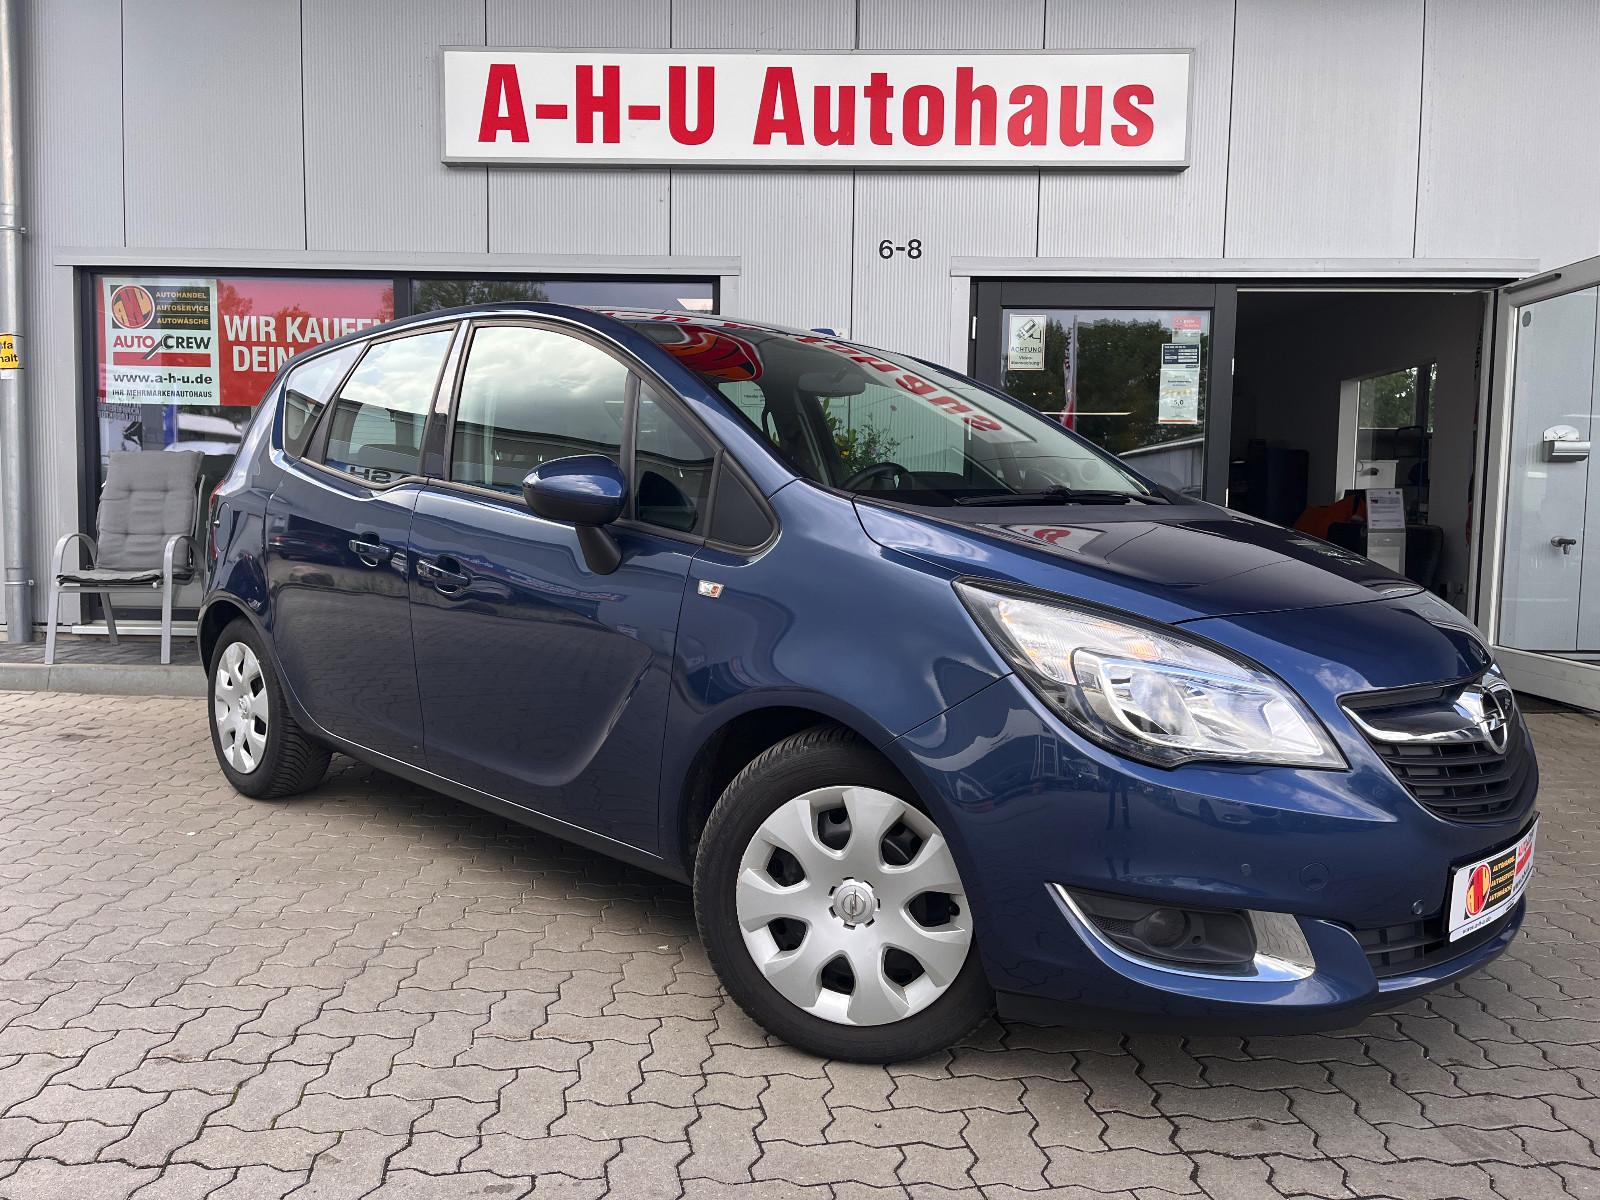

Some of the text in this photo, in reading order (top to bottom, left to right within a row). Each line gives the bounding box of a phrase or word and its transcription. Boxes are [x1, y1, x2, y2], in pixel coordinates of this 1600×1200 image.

[478, 63, 1155, 147] A-H-U Autohaus
[878, 239, 923, 260] 6-8
[156, 291, 207, 299] AUTOHANDEL
[156, 304, 209, 312] AUTOSERVICE
[224, 315, 277, 342] WIR
[113, 334, 211, 349] AUTO CREW
[113, 373, 212, 385] www.a-h-u.de
[126, 389, 212, 398] MEHRMARKENAUTOHAUS
